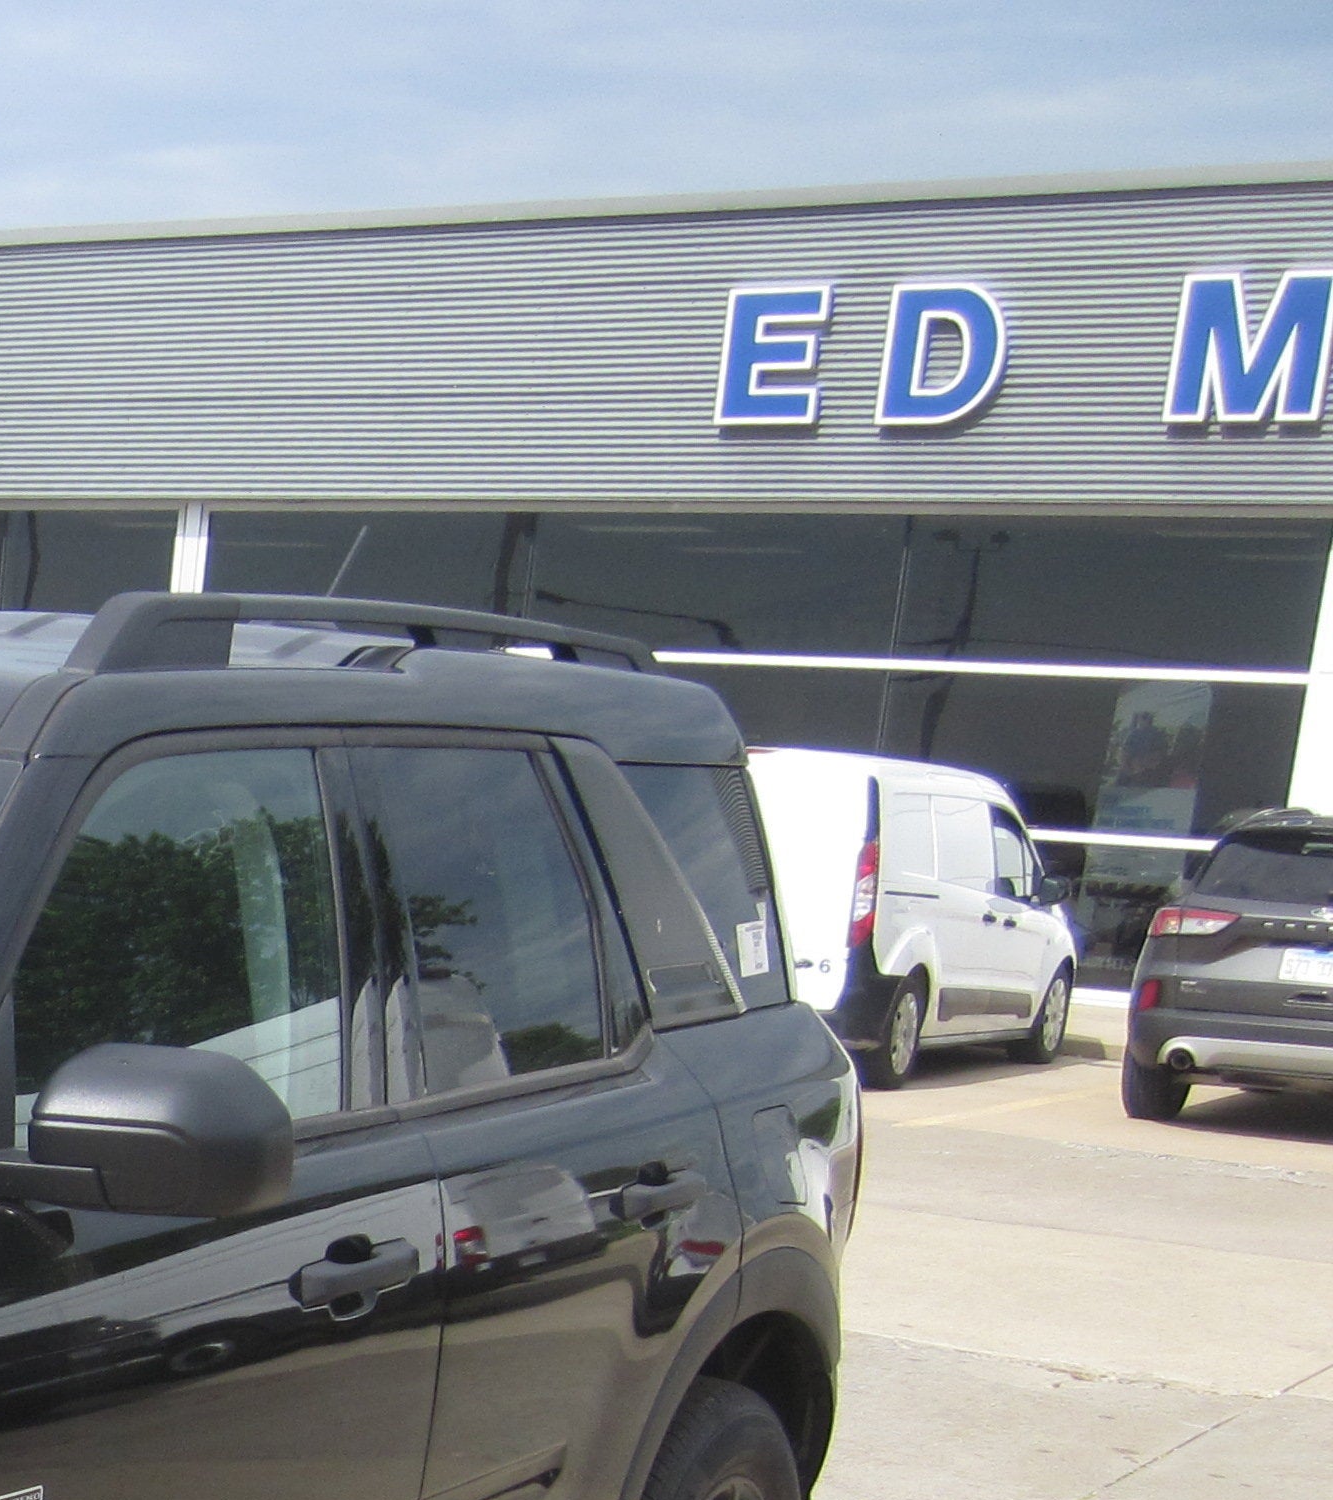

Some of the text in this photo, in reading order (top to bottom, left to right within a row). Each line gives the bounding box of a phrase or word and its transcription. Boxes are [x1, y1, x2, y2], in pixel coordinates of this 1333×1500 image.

[713, 268, 1333, 426] ED M
[819, 958, 832, 974] 6
